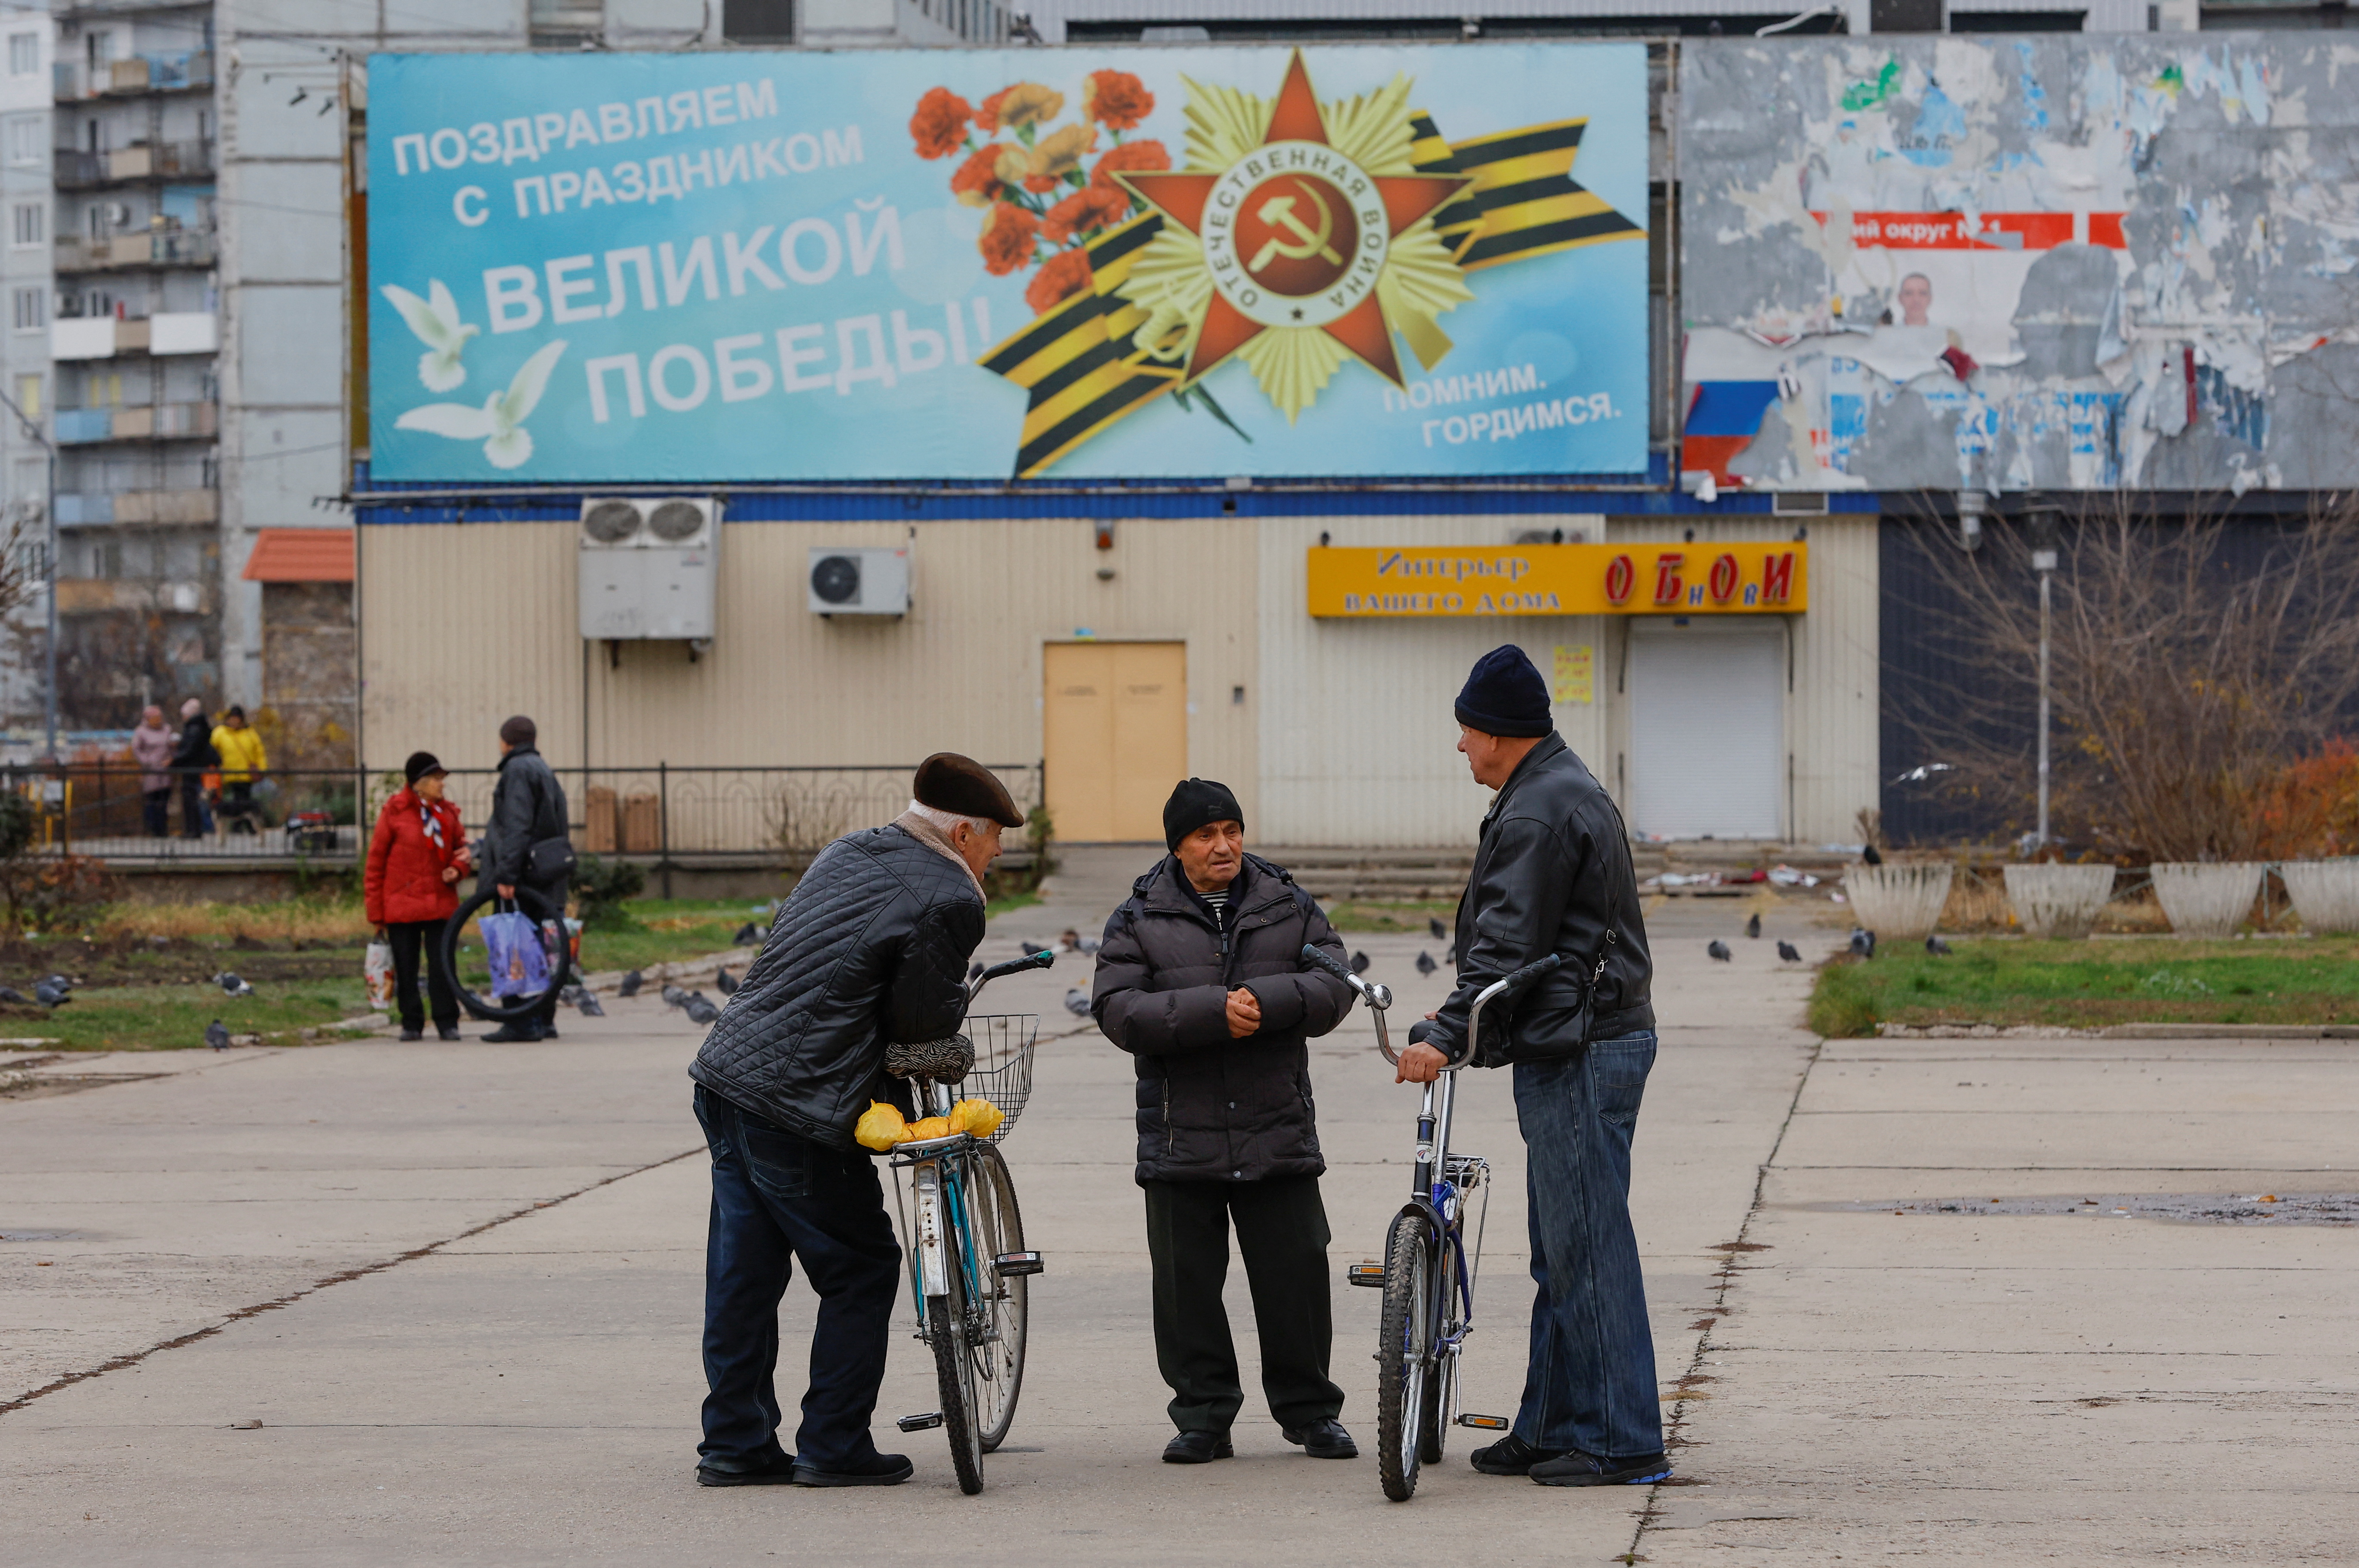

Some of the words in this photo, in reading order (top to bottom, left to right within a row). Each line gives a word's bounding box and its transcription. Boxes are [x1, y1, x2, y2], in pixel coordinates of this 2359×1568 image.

[393, 77, 778, 176] ПОЗДРАВЛЯЕМ
[452, 185, 490, 226] С
[513, 124, 865, 219] ПРАЗДНИКОМ
[482, 194, 906, 335] ВЕЛИКОЙ
[1209, 148, 1367, 308] ОТЕЧЕСТВЕННАЯ
[1885, 221, 1952, 244] округ
[585, 296, 992, 424] ПОБЕДЫ!
[1382, 363, 1547, 413] ПОМНИМ.
[1422, 391, 1623, 448] ГОРДИМСЯ.
[1344, 592, 1464, 612] ВАШЕГО
[1474, 592, 1561, 614] ДОМА
[1377, 551, 1530, 583] Интерьер
